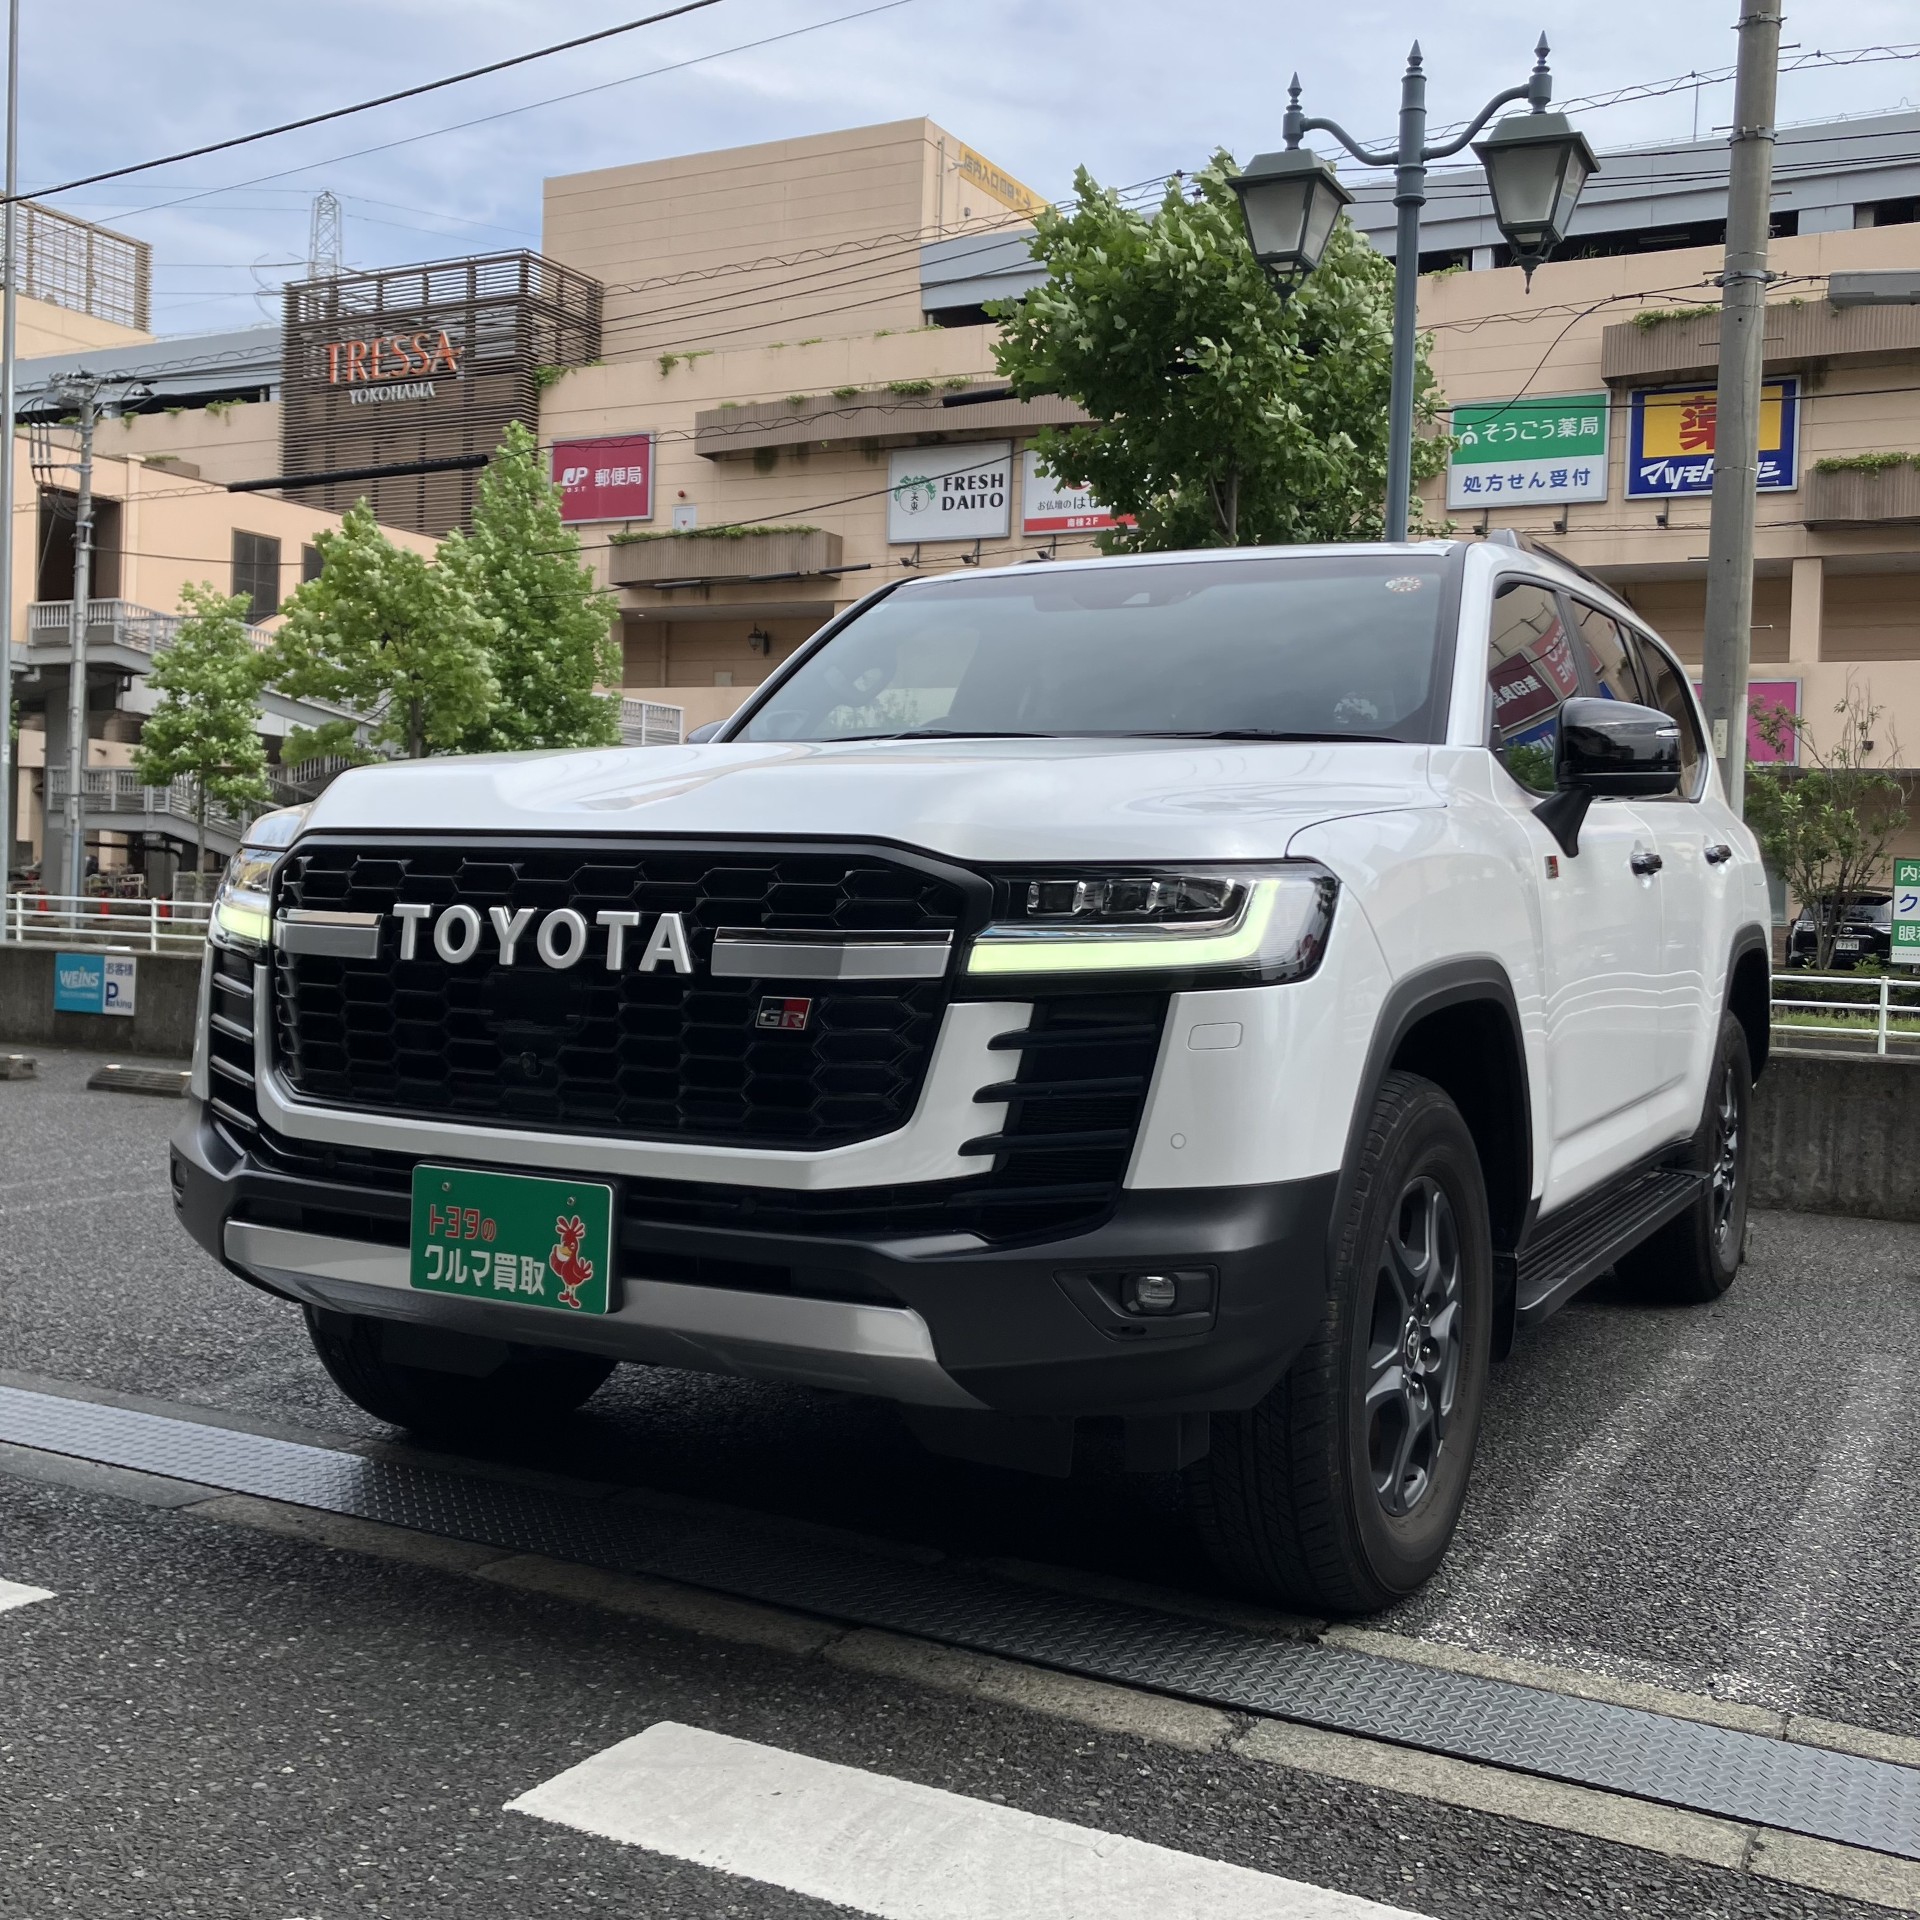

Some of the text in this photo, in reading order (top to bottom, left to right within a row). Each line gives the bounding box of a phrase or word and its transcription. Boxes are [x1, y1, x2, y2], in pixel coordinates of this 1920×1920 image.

[324, 330, 465, 384] TRESSA
[350, 382, 436, 405] YOKOHAMA
[1482, 416, 1598, 443] そうごう薬局
[562, 466, 642, 487] JP 郵便局
[943, 473, 1004, 492] FRESH
[1463, 467, 1591, 493] 処方せん受付
[941, 492, 1004, 511] DAITO
[1900, 865, 1920, 881] 内
[1899, 894, 1918, 912] ク
[393, 903, 692, 974] TOYOTA
[758, 1006, 806, 1028] GR
[429, 1204, 497, 1242] トヨタの
[424, 1244, 546, 1296] クルマ買取
